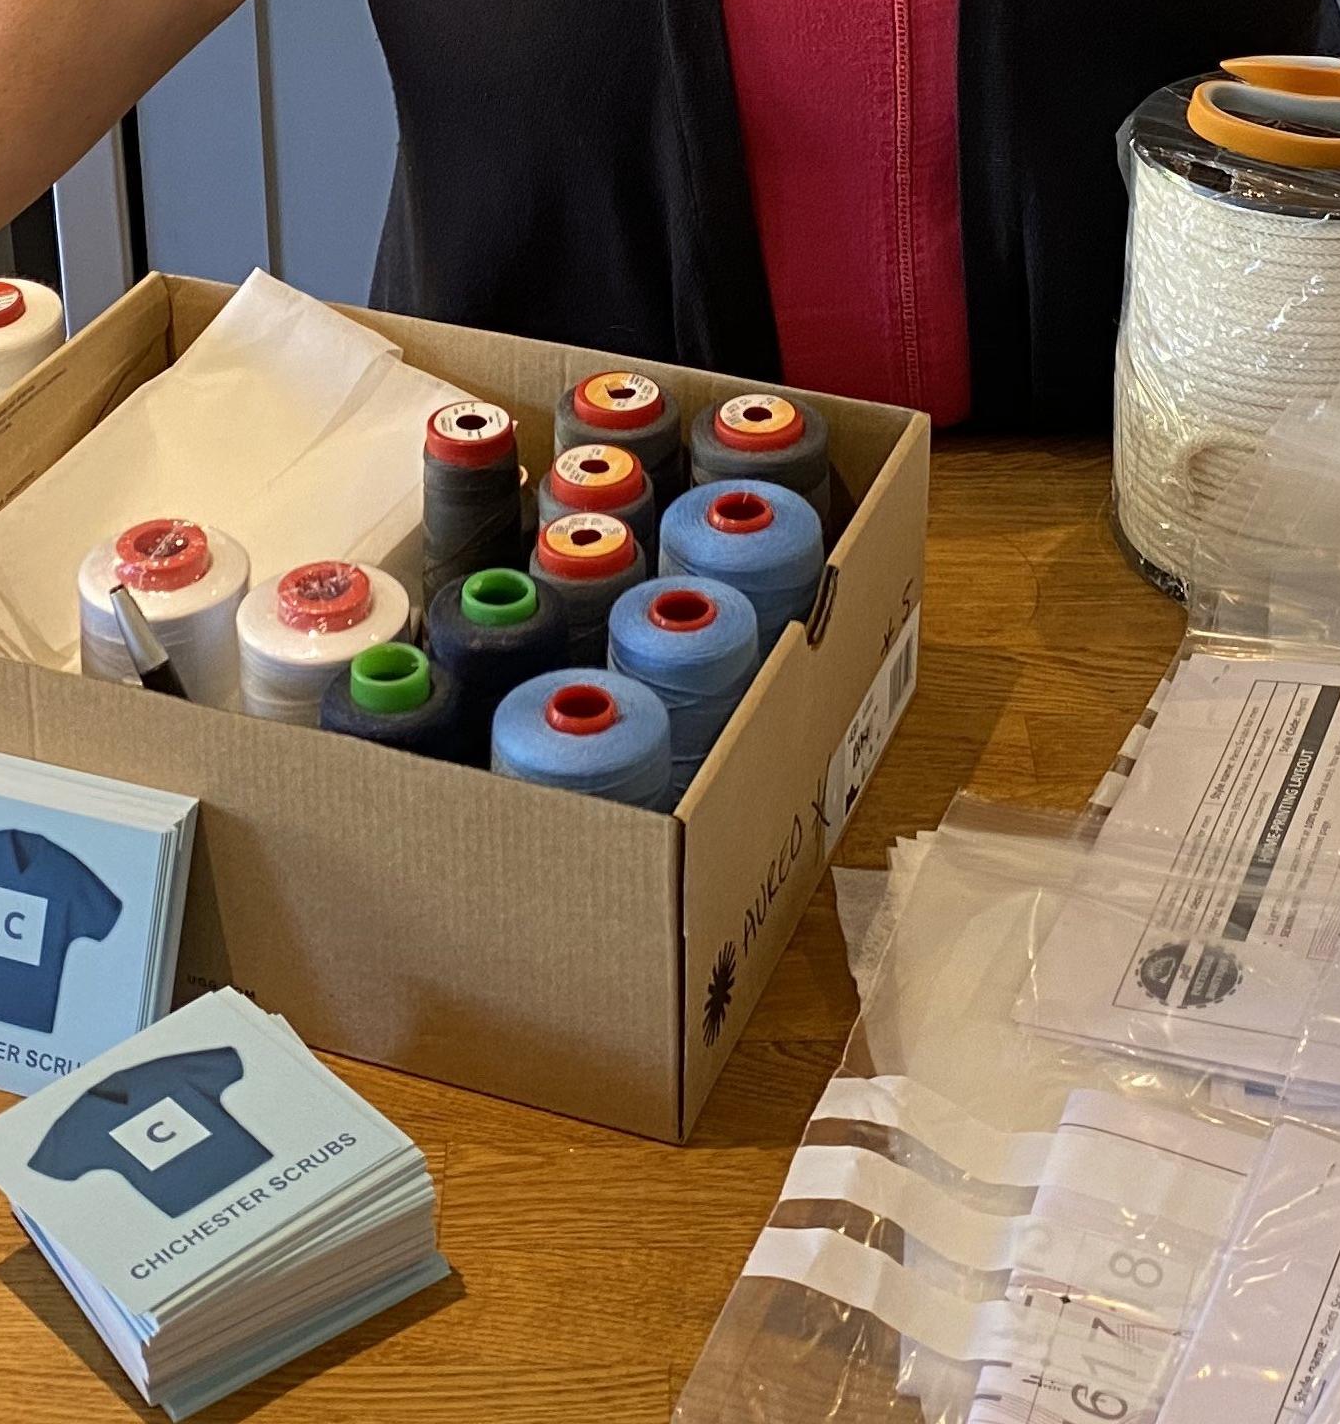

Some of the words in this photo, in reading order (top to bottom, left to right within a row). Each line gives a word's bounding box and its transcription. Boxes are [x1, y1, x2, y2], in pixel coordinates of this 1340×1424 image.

[1258, 787, 1299, 864] HOME-PRINTING
[1293, 749, 1315, 788] LAYEOUT
[4, 910, 26, 941] C
[146, 1121, 177, 1144] C
[130, 1187, 267, 1281] CHICHESTER
[268, 1132, 358, 1193] SCRUBS
